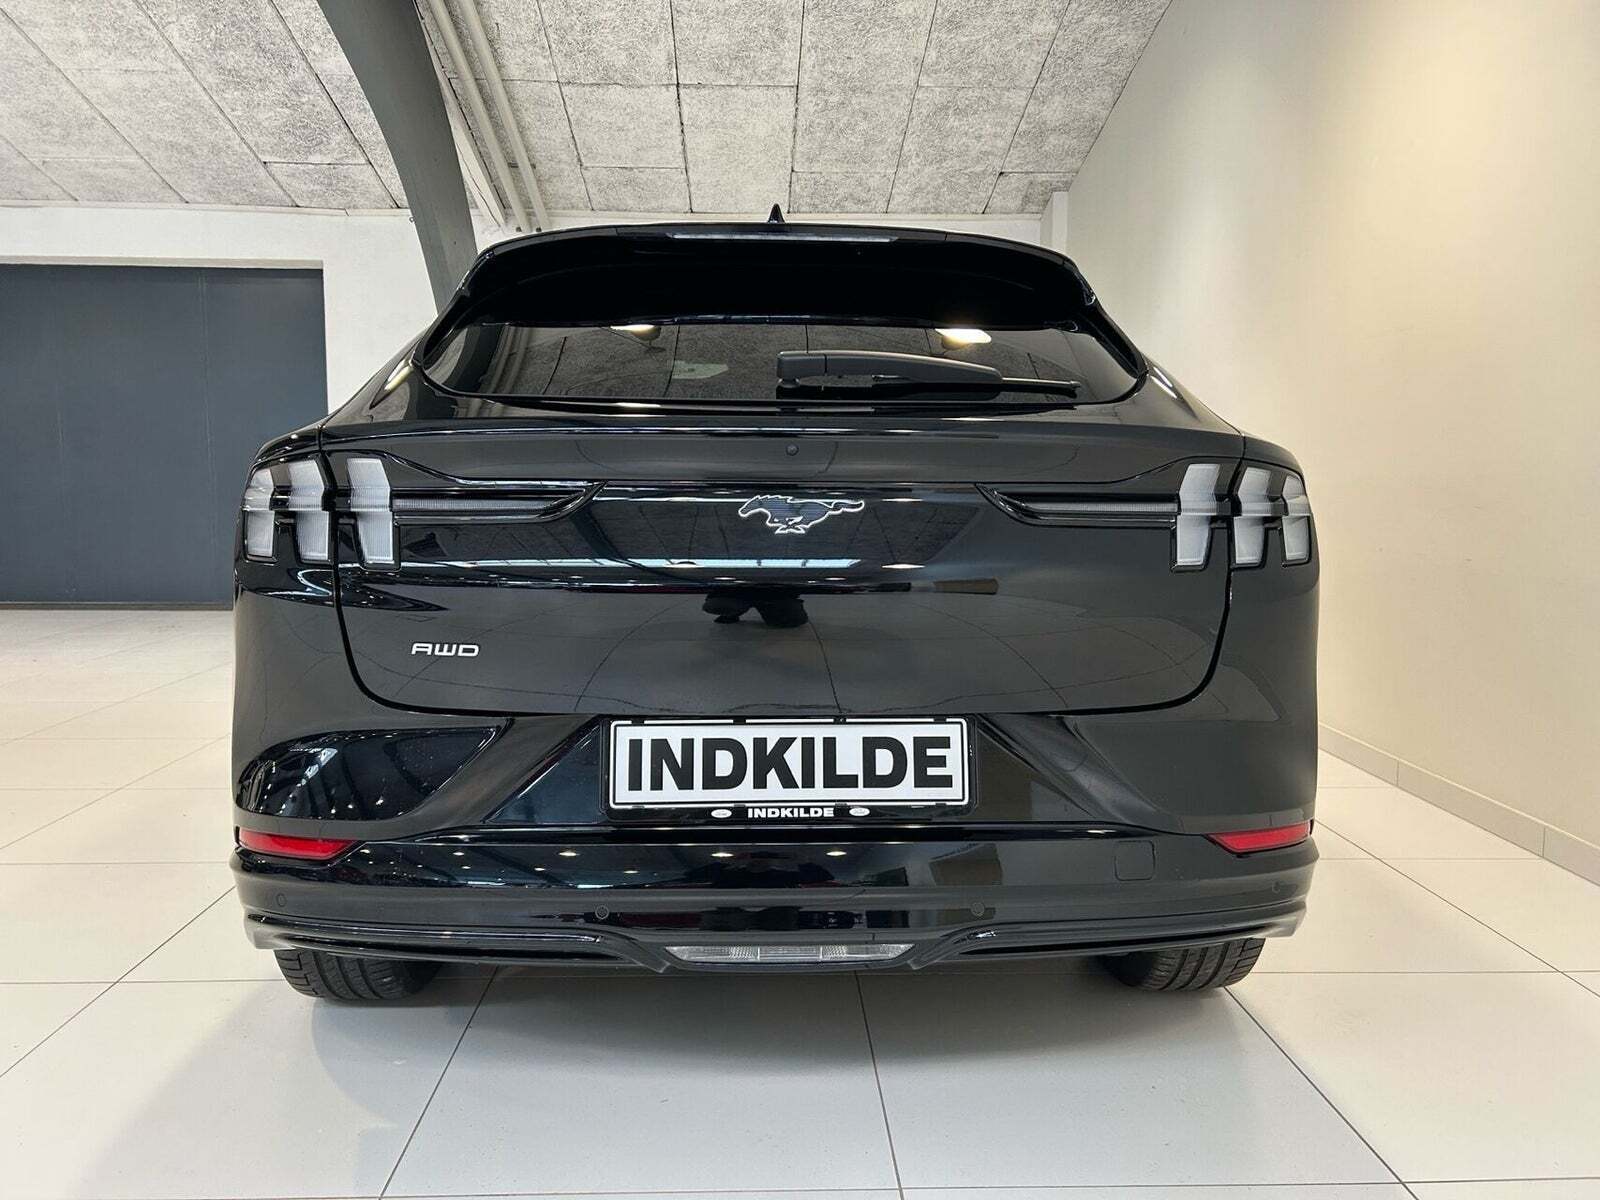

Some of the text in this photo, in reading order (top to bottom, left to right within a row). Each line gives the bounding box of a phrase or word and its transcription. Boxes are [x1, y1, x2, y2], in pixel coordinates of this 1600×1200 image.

[411, 642, 480, 657] AWD
[627, 736, 953, 791] INDKILDE
[747, 807, 835, 818] INDKILDE
